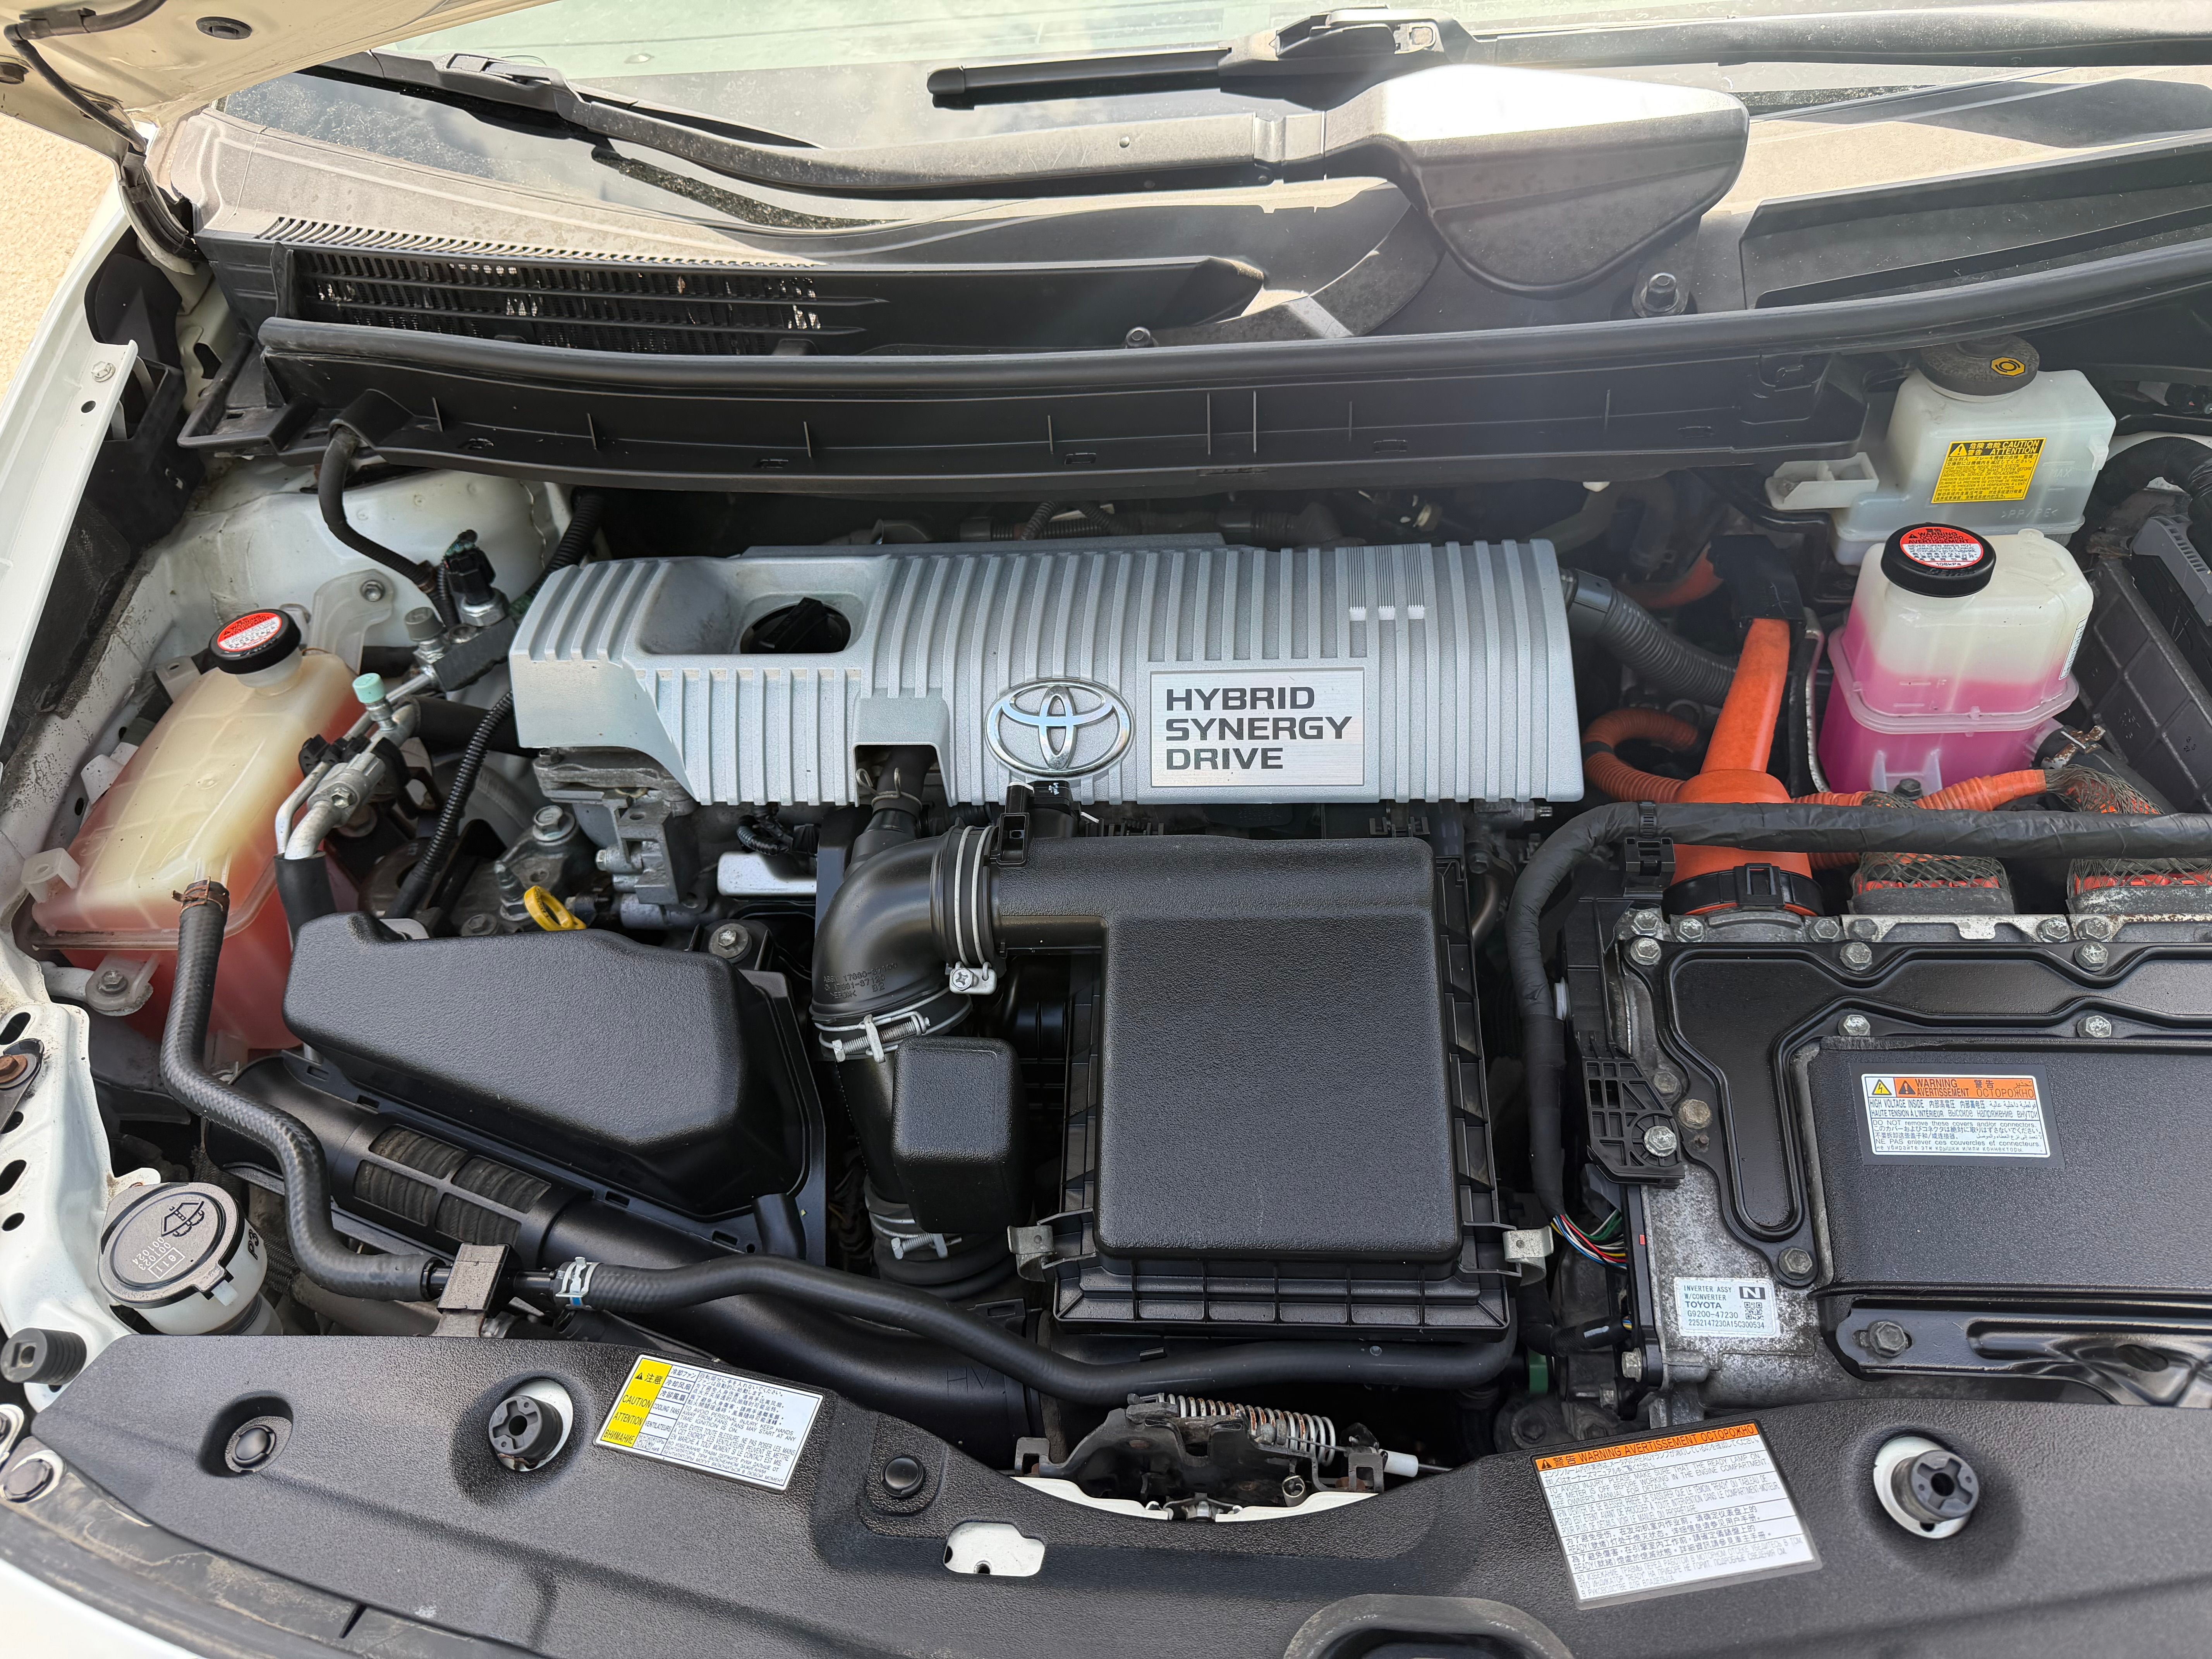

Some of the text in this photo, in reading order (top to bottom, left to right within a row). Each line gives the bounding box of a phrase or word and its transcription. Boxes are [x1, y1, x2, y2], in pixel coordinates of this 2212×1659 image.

[1990, 447, 2037, 455] ATTENTION
[1166, 687, 1315, 711] HYBRID
[1166, 716, 1352, 741] SYNERGY
[1166, 747, 1283, 770] DRIVE
[872, 982, 885, 992] B2
[1915, 1079, 1958, 1088] WARNING
[1974, 1079, 1994, 1088] 警告
[1917, 1088, 2034, 1098] AVERTISSEMENT ОСТОРОЖНО
[1869, 1099, 1882, 1108] HIGH
[1883, 1099, 1906, 1108] VOLTAGE
[1907, 1099, 1924, 1108] INSIDE
[1871, 1109, 1888, 1117] HAUTE
[132, 1237, 165, 1265] 001024
[247, 1229, 260, 1261] P3
[138, 1242, 171, 1271] 001023
[1685, 1301, 1722, 1309] TOYOTA
[1687, 1310, 1738, 1319] G9200-47230
[1688, 1319, 1765, 1329] 2252147230A15C300534
[644, 1373, 663, 1385] 注意
[946, 1366, 991, 1395] HV
[622, 1394, 653, 1409] CAUTION
[653, 1403, 670, 1412] COOLING
[613, 1411, 644, 1426] ATTENTION
[645, 1420, 672, 1432] VENTILATEURS
[695, 1419, 719, 1429] IGNITION
[711, 1412, 737, 1423] PERSONAL
[775, 1427, 794, 1436] HANDS
[603, 1429, 635, 1444] ВНИМАНИЕ
[758, 1429, 775, 1437] START
[704, 1428, 718, 1437] TOUTE
[757, 1441, 773, 1450] POSER
[782, 1447, 796, 1456] MAINS
[1552, 1425, 1754, 1467] 警告 WARNING AVERTISSEMENT ОСТОРОЖНО
[1561, 1484, 1580, 1492] AVOID
[1608, 1474, 1632, 1484] PLEASE
[1633, 1471, 1652, 1480] MAKE
[1654, 1467, 1671, 1476] SURE
[1672, 1464, 1689, 1473] THAT
[1692, 1462, 1705, 1470] THE
[1707, 1458, 1727, 1467] READY
[1729, 1455, 1747, 1463] LAMP
[1550, 1493, 1564, 1501] THE
[1565, 1489, 1587, 1499] METER
[1598, 1484, 1611, 1493] OFF
[1613, 1480, 1638, 1491] BEFORE
[1639, 1475, 1669, 1486] WORKING
[1680, 1470, 1694, 1479] THE
[1695, 1467, 1718, 1476] ENGINE
[1553, 1500, 1565, 1508] SEE
[1597, 1490, 1624, 1500] MANUAL
